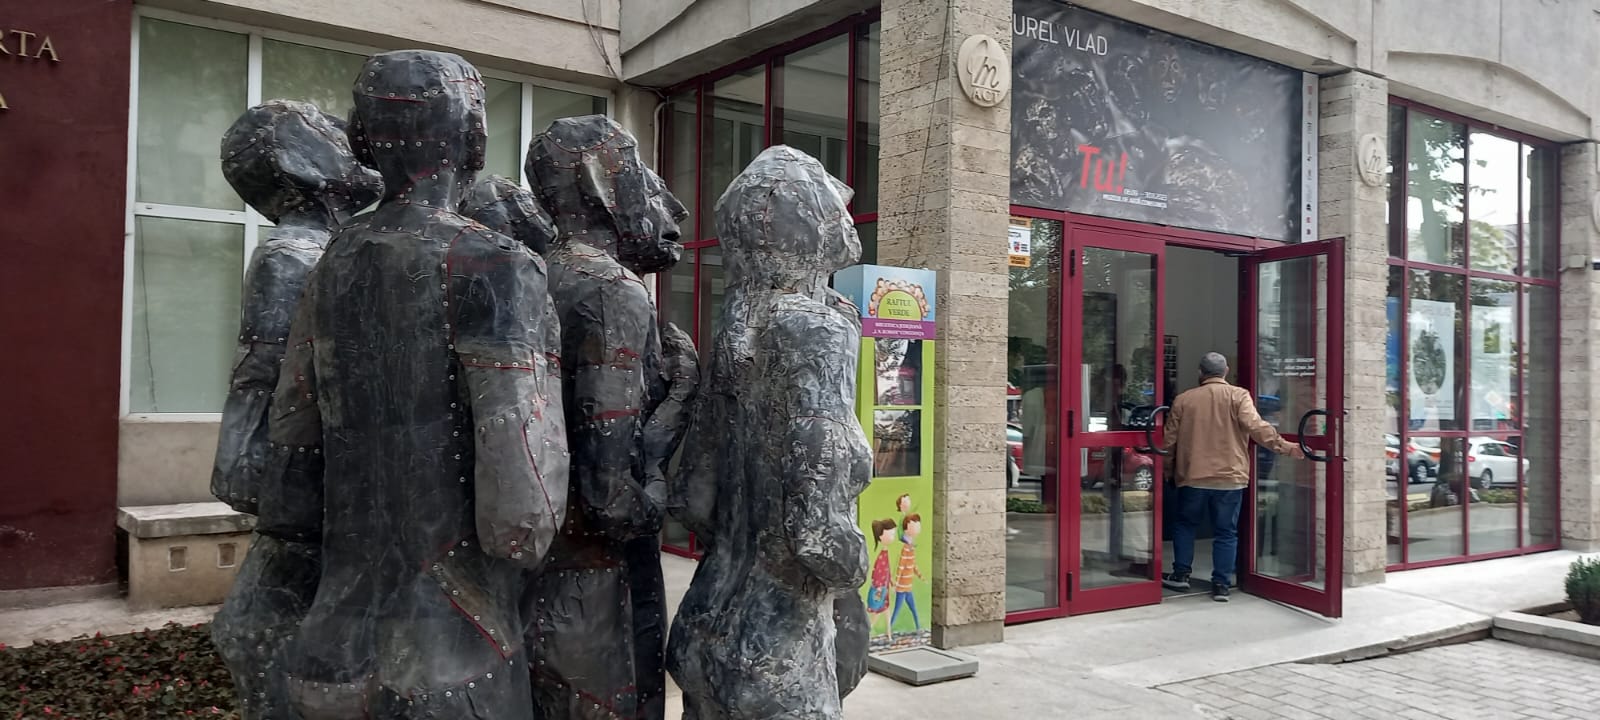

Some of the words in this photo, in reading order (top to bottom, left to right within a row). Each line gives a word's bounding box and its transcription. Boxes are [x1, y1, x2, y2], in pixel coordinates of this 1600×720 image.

[1064, 25, 1108, 56] VLAD
[971, 89, 1001, 103] ACT
[1078, 144, 1128, 195] Tu!
